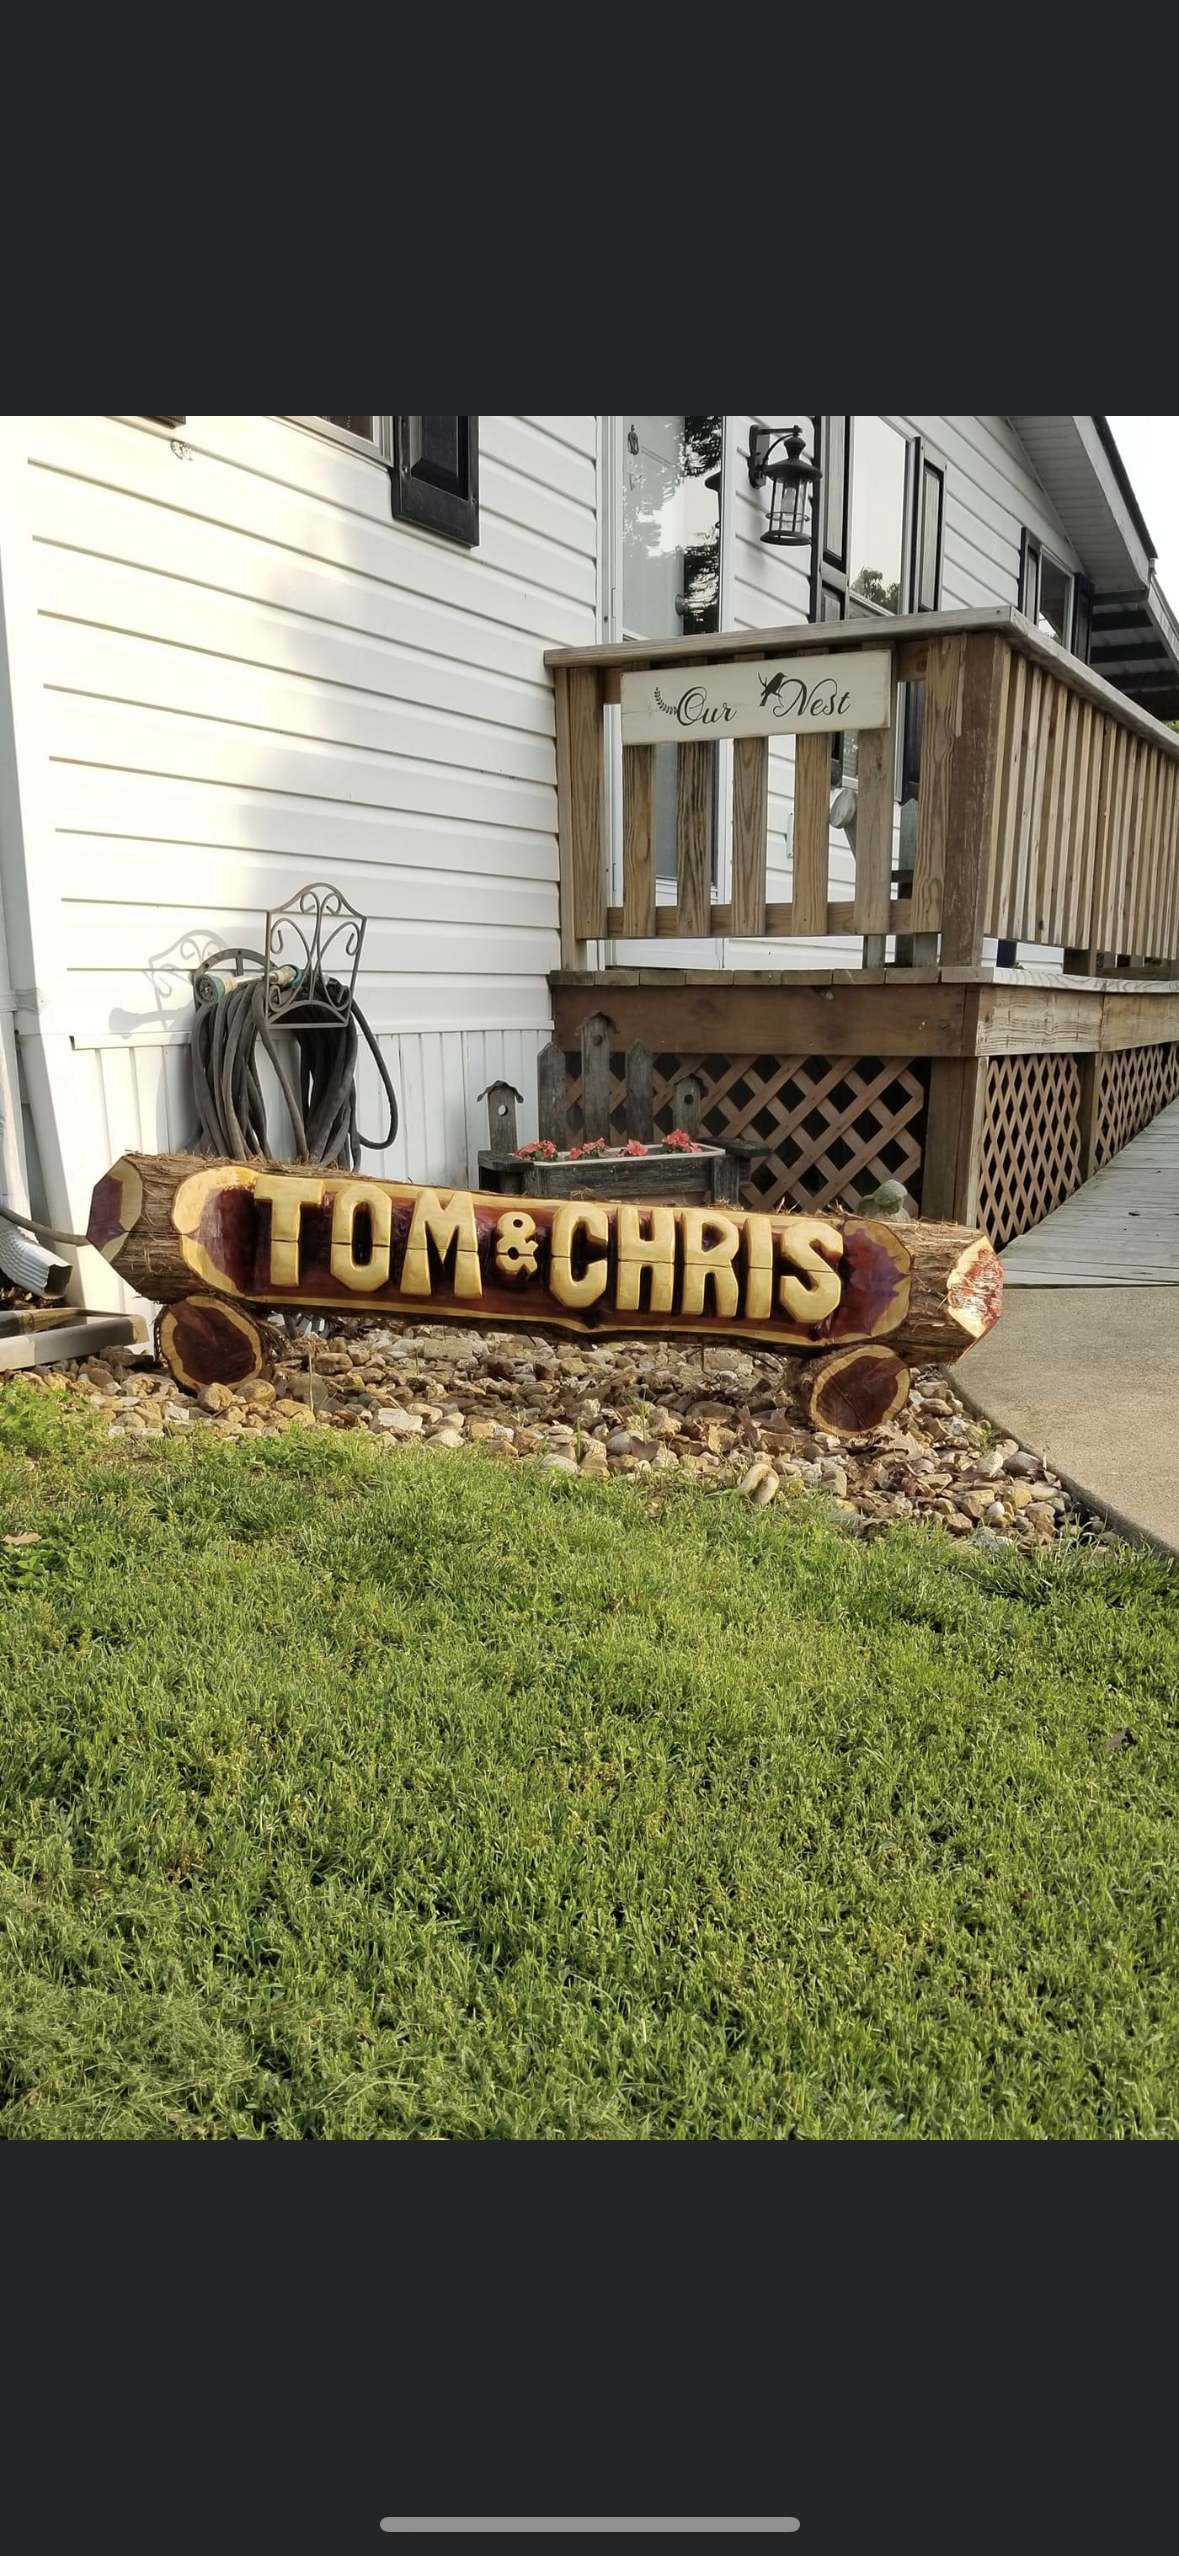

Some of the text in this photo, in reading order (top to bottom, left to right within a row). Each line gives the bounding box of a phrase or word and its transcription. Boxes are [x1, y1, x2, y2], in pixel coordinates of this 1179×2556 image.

[676, 678, 850, 726] Our Nest
[253, 1175, 483, 1299] TOM
[549, 1203, 844, 1323] CHRIS
